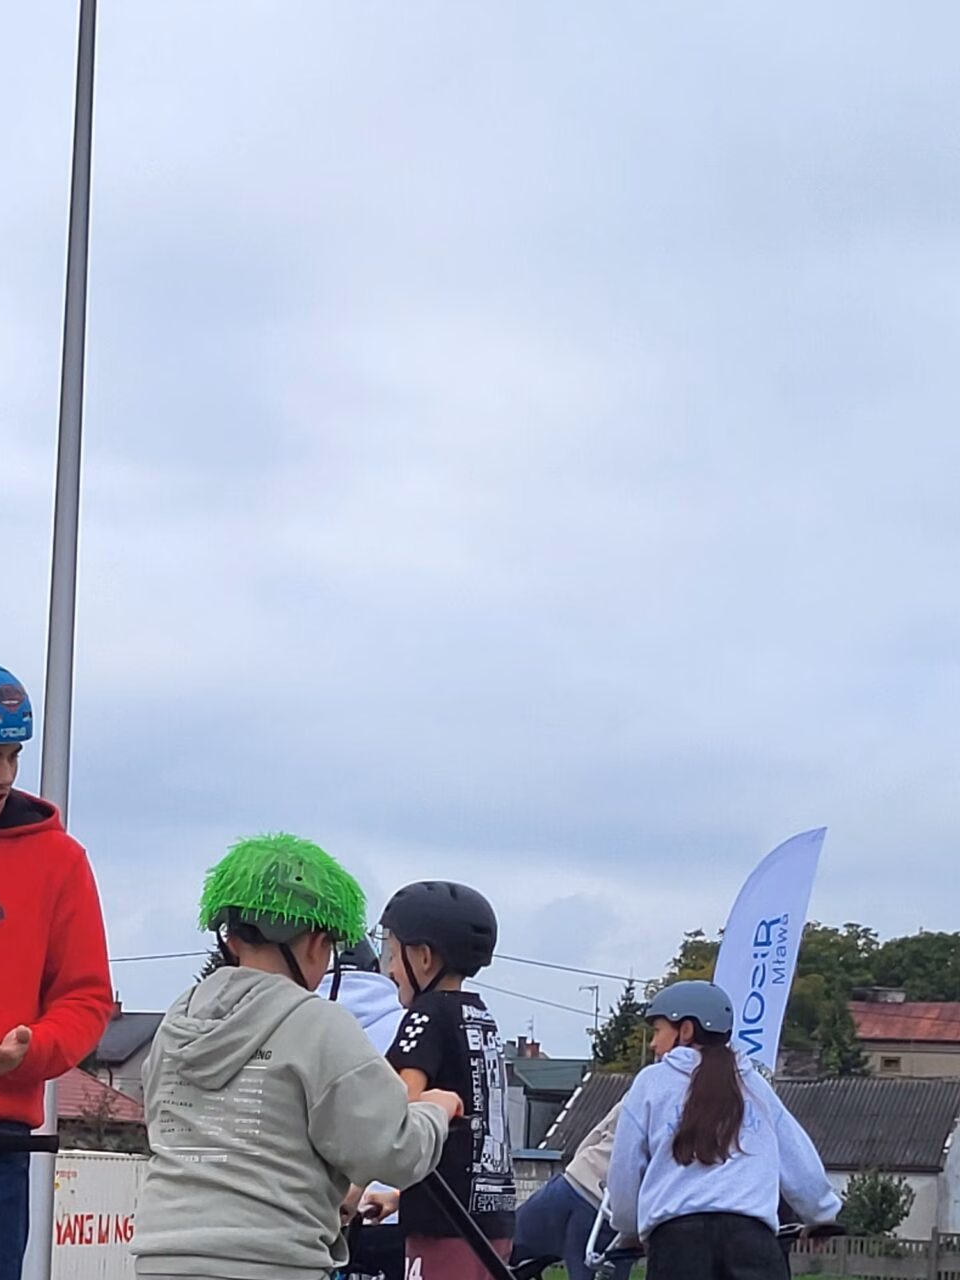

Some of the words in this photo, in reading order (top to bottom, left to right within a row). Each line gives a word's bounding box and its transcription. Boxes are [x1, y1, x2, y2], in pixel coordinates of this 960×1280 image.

[772, 913, 789, 985] Mława
[56, 1213, 94, 1246] YANG
[97, 1213, 135, 1243] MNG
